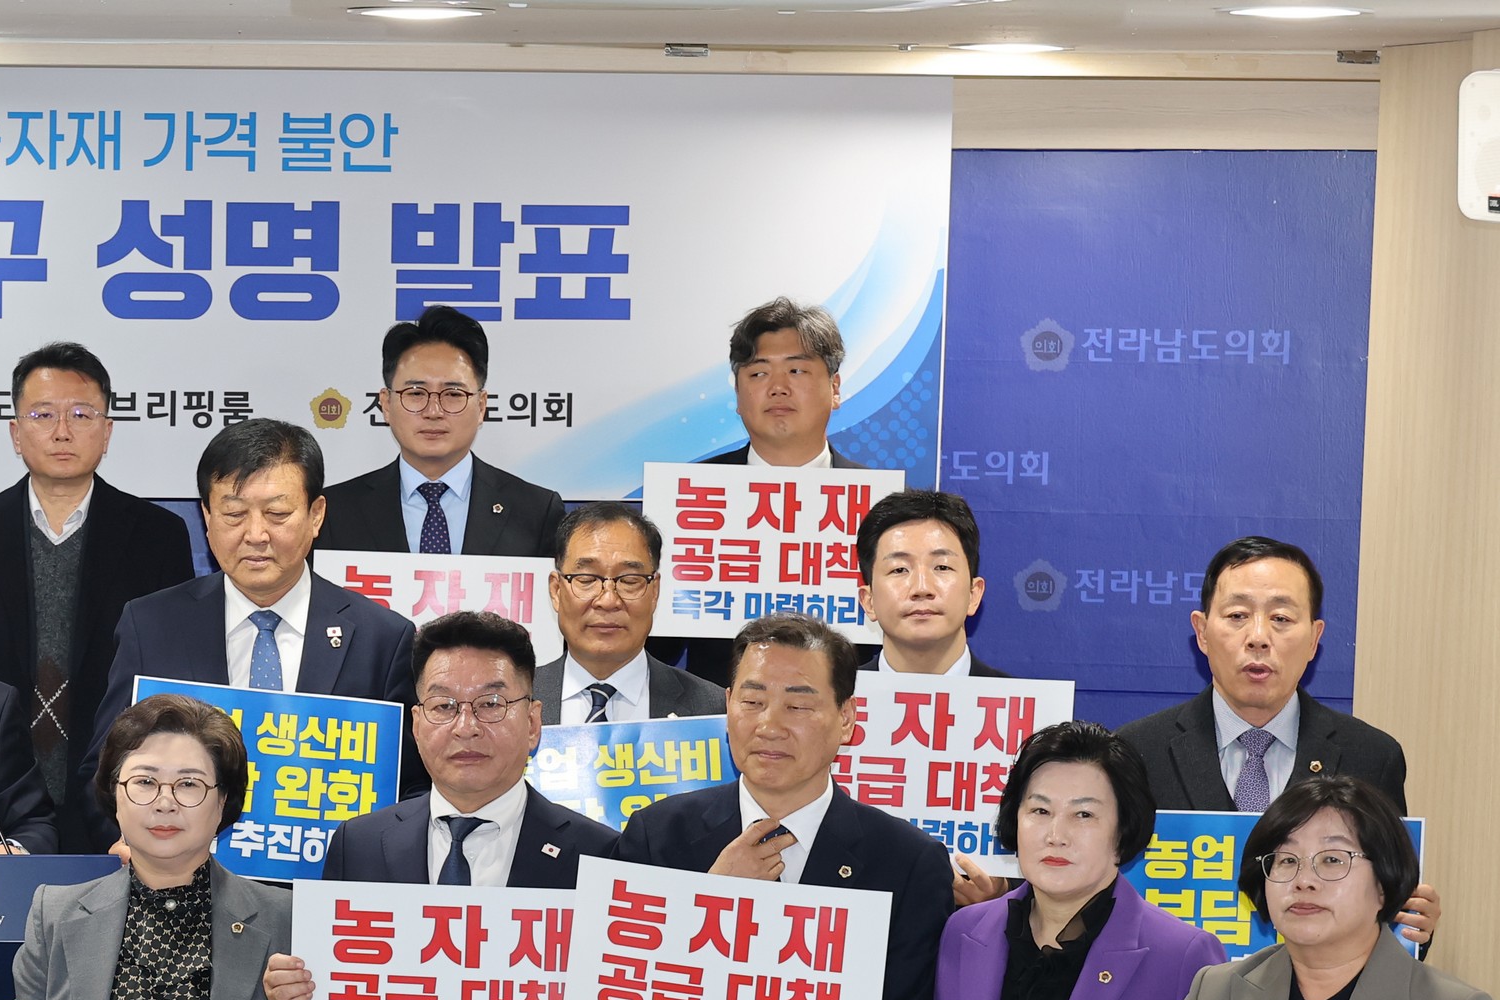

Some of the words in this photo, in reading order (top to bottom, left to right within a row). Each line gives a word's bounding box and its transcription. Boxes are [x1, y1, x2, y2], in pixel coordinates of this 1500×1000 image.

[143, 111, 257, 172] 가격
[278, 112, 399, 173] 불안
[97, 199, 340, 320] 성명
[391, 202, 631, 322] 발표
[1081, 328, 1291, 364] 전라남도의회
[109, 390, 254, 428] 브리핑룸
[671, 537, 762, 584] 공급
[778, 541, 867, 589] 대책
[1074, 569, 1206, 604] 전라남도
[672, 589, 734, 621] 즉각
[257, 713, 377, 764] 생산비
[593, 738, 722, 788] 생산비
[274, 766, 377, 821] 완화
[230, 820, 336, 863] 추진하
[1144, 833, 1235, 880] 농업
